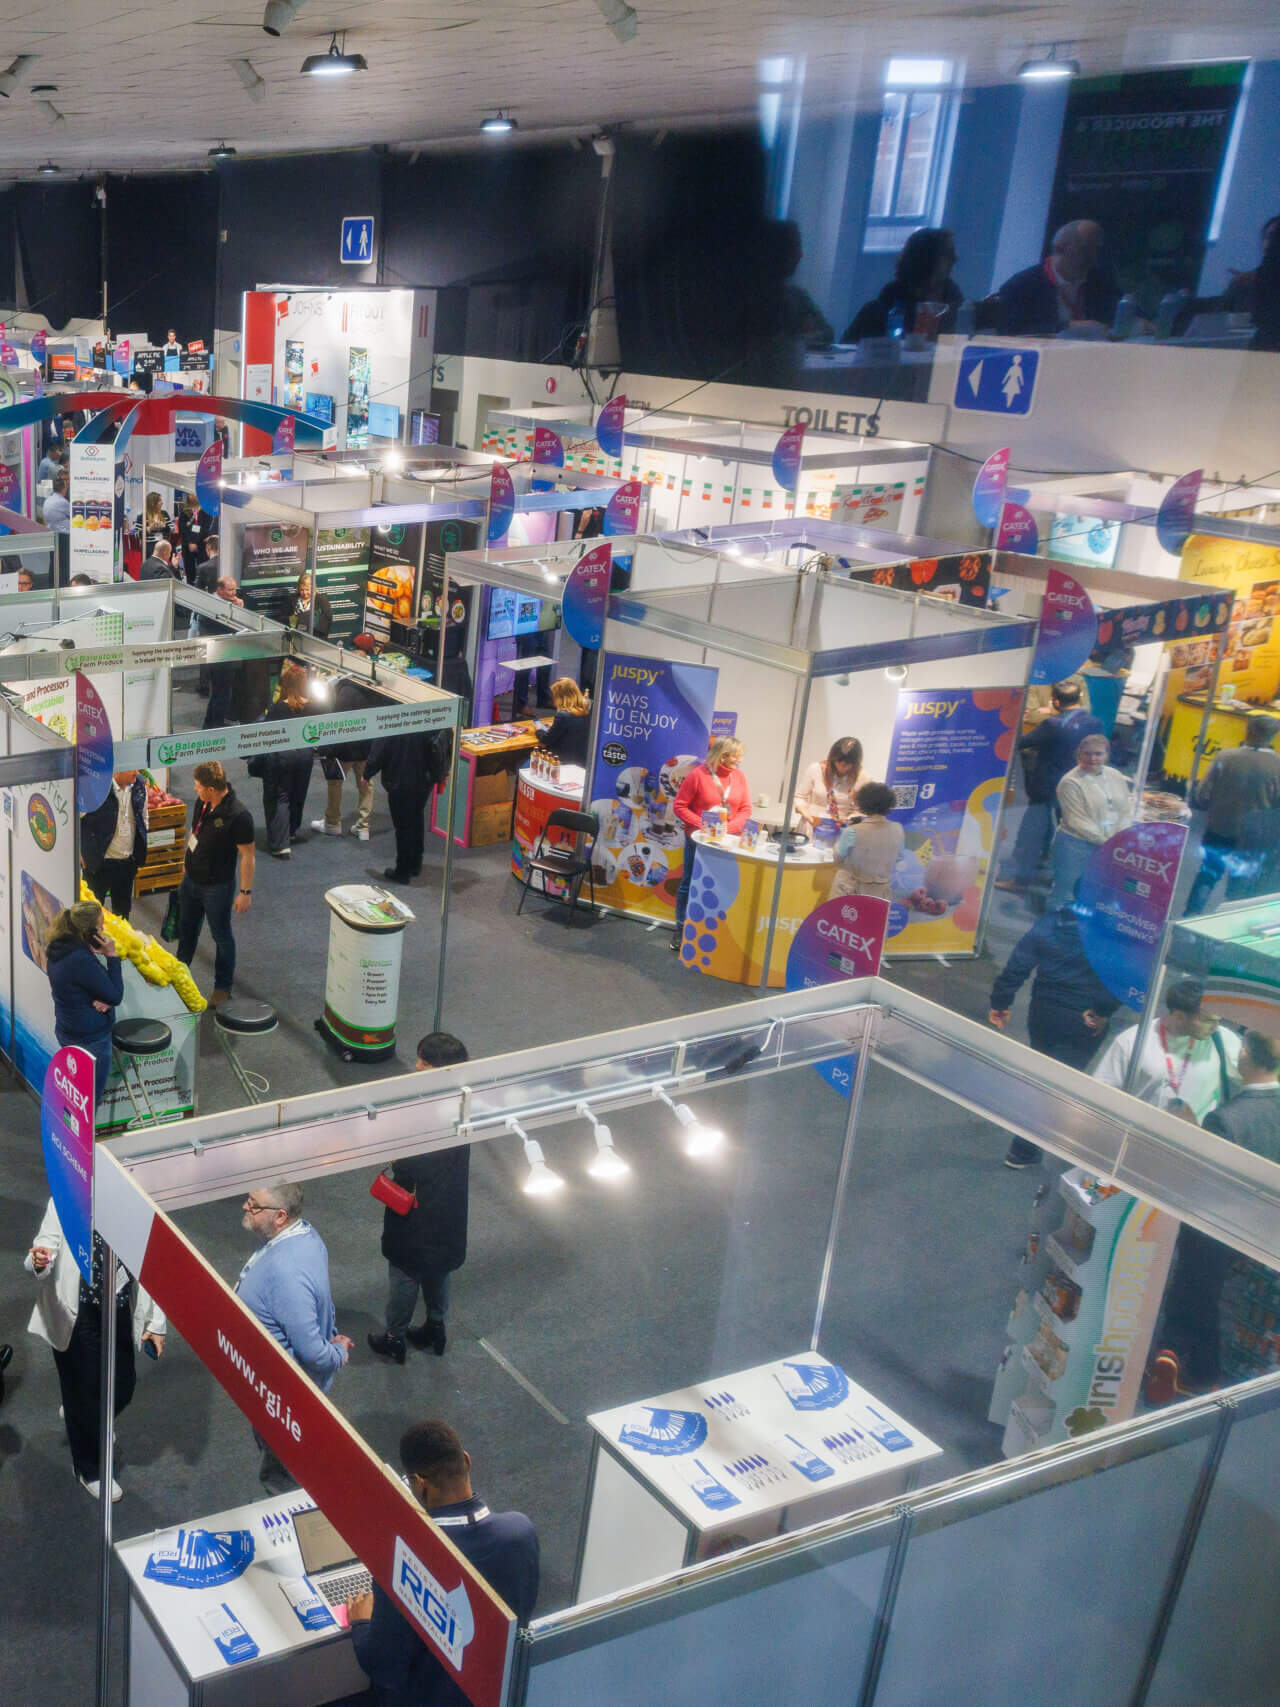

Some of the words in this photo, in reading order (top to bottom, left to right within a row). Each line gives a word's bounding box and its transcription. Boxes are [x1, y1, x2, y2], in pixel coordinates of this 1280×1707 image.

[782, 406, 880, 437] TOILETS
[175, 427, 199, 439] VITA
[175, 438, 201, 447] COCO
[1003, 520, 1031, 531] CATEX
[254, 547, 270, 555] WHO
[317, 542, 365, 552] USTAINABILITY
[577, 562, 607, 575] CATEX
[1048, 592, 1086, 609] CATEX
[611, 664, 658, 686] juspy
[36, 680, 69, 698] Processors
[608, 690, 649, 709] WAYS
[77, 702, 104, 725] CATEX
[607, 706, 625, 721] TO
[629, 711, 678, 730] ENJOY
[904, 700, 959, 719] juspy
[318, 729, 336, 737] Farm
[338, 725, 366, 735] Produce
[605, 723, 652, 740] JUSPY
[175, 748, 194, 759] Farm
[196, 745, 226, 757] Produce
[603, 749, 627, 761] taste
[1112, 848, 1173, 883] CATEX
[816, 919, 876, 960] CATEX
[53, 1067, 89, 1123] CATEX
[51, 1132, 62, 1153] RGI
[62, 1146, 88, 1182] SCHEME
[78, 1244, 89, 1268] P2
[217, 1329, 302, 1442] www.rgi.ie
[401, 1560, 455, 1646] RGI
